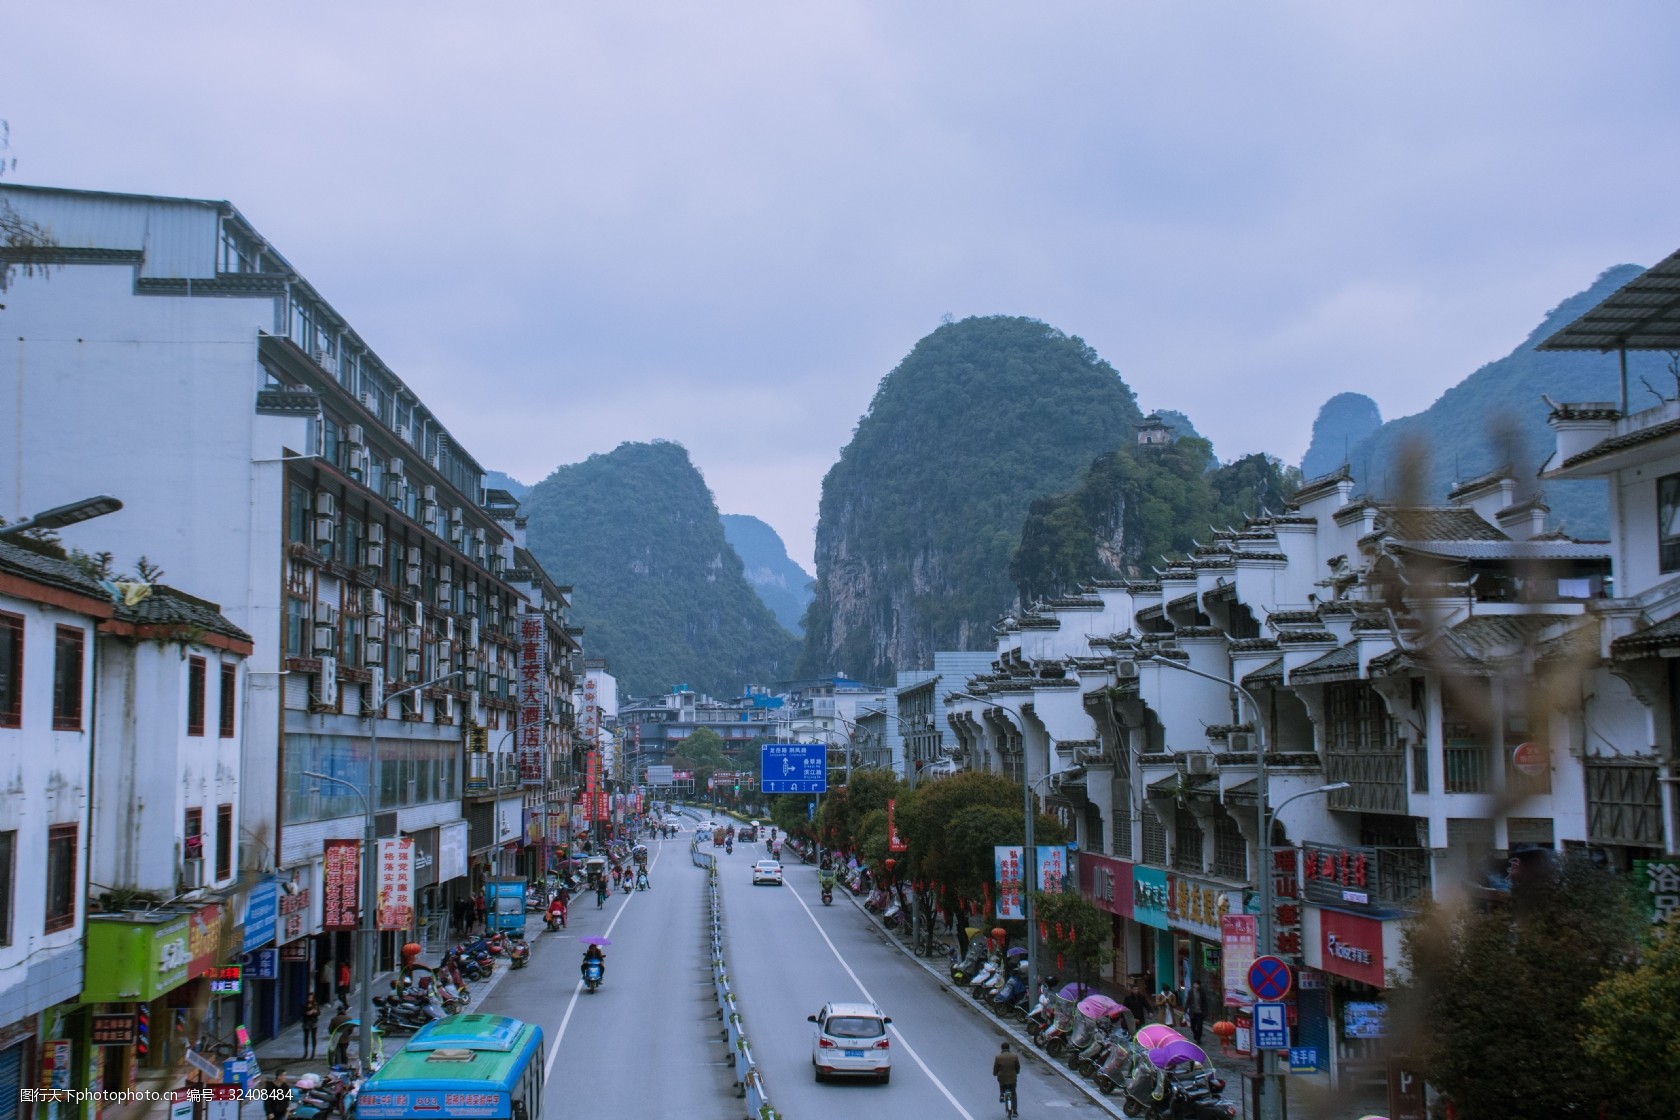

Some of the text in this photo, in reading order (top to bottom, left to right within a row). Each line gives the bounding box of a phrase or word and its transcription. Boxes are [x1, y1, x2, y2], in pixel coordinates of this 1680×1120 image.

[521, 619, 542, 748] 新富安大酒店
[326, 846, 341, 926] 推进扶贫攻坚
[341, 846, 357, 926] 培育富民产业
[383, 841, 395, 925] 严格落实两个责任
[397, 840, 410, 925] 加强党风廉政建设
[1274, 849, 1299, 954] 瑶山客栈
[1305, 848, 1367, 888] 瑶山客栈
[259, 950, 272, 977] 停车场
[1290, 1050, 1318, 1065] 洗手间
